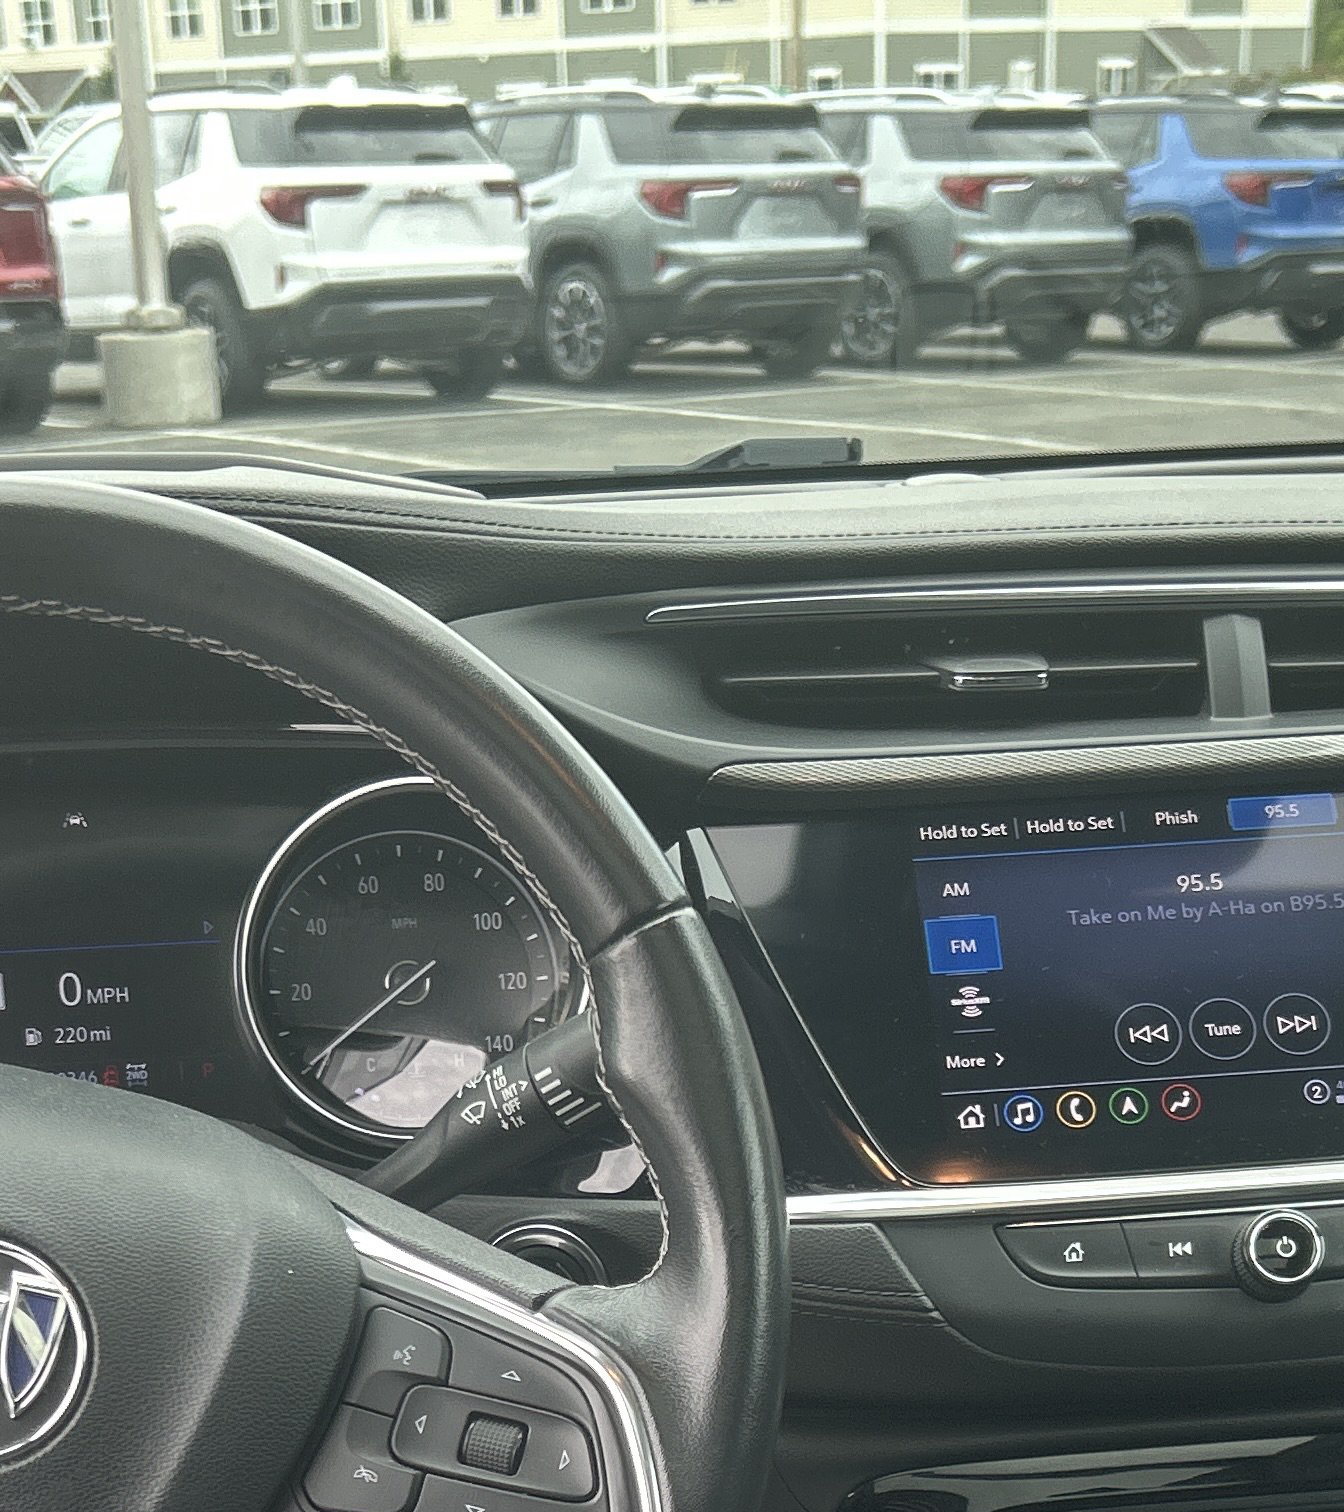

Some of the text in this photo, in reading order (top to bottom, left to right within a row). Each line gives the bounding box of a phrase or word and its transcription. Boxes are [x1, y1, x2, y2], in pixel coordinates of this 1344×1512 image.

[1155, 810, 1198, 826] Phish
[1264, 804, 1299, 818] 95.5
[920, 823, 1007, 841] Hold to Set
[1026, 816, 1114, 834] Hold to Set
[358, 876, 379, 894] 60
[424, 873, 445, 892] 80
[943, 883, 970, 897] AM
[1177, 873, 1223, 893] 95.5
[1067, 908, 1112, 926] Take
[1118, 910, 1142, 922] on
[1147, 905, 1177, 921] Me
[1182, 902, 1203, 922] by
[1208, 898, 1255, 917] A-Ha
[1261, 901, 1284, 914] on
[304, 918, 327, 937] 40
[391, 917, 418, 929] MPH
[473, 912, 503, 931] 100
[950, 940, 977, 954] FM
[58, 972, 130, 1007] 0 MPH
[497, 971, 527, 992] 120
[290, 982, 312, 1002] 20
[54, 1025, 111, 1044] 220 mi
[1205, 1022, 1242, 1037] Tune
[485, 1034, 514, 1053] 140
[366, 1058, 376, 1073] C
[454, 1053, 465, 1067] H
[946, 1055, 986, 1069] More
[492, 1065, 503, 1078] HI
[494, 1076, 507, 1091] LO
[501, 1083, 519, 1102] INT
[1312, 1086, 1323, 1099] 2
[502, 1099, 522, 1117] OFF
